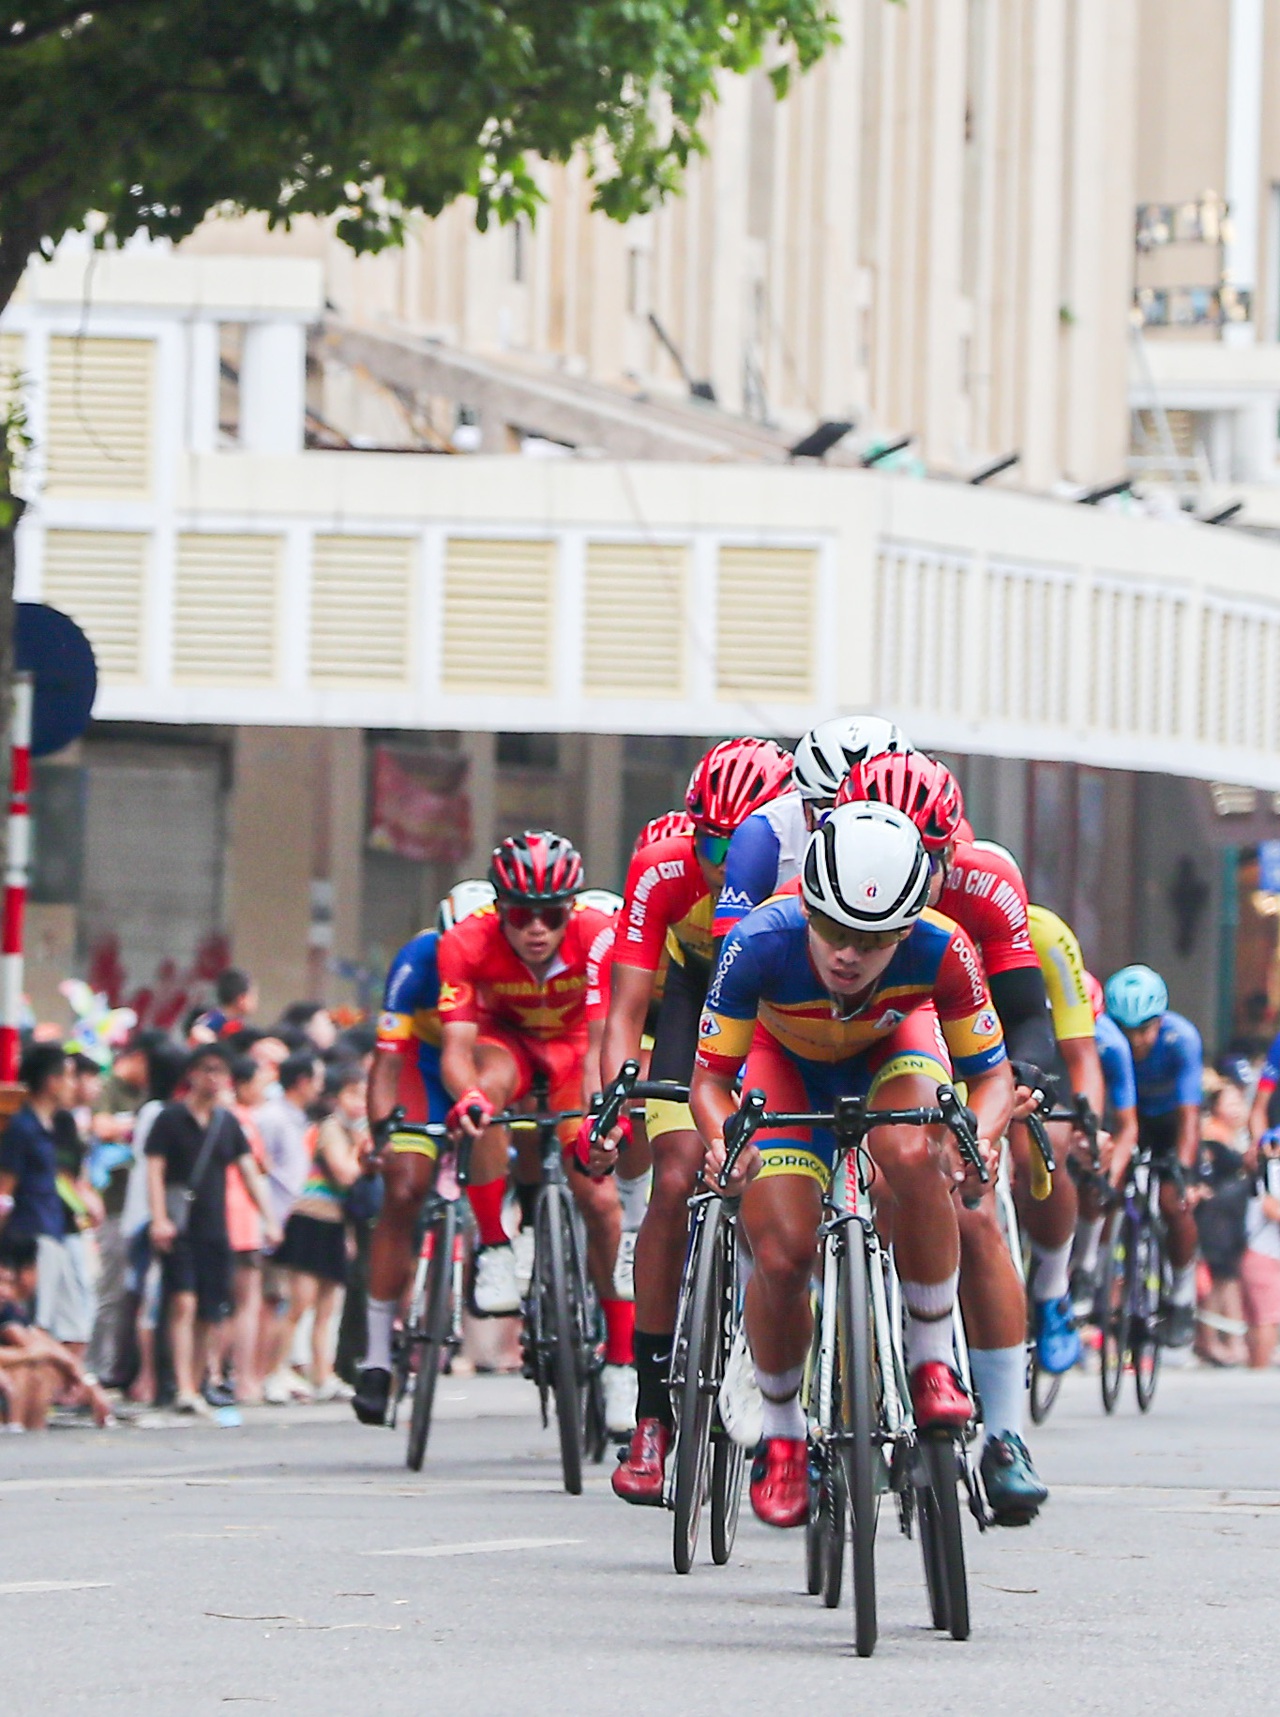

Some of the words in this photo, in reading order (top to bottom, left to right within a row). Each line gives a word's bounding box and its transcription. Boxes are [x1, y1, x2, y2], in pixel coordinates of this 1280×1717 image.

[629, 900, 647, 926] CHI
[657, 860, 685, 880] CITY
[964, 869, 998, 898] CHI
[990, 879, 1027, 931] MINH
